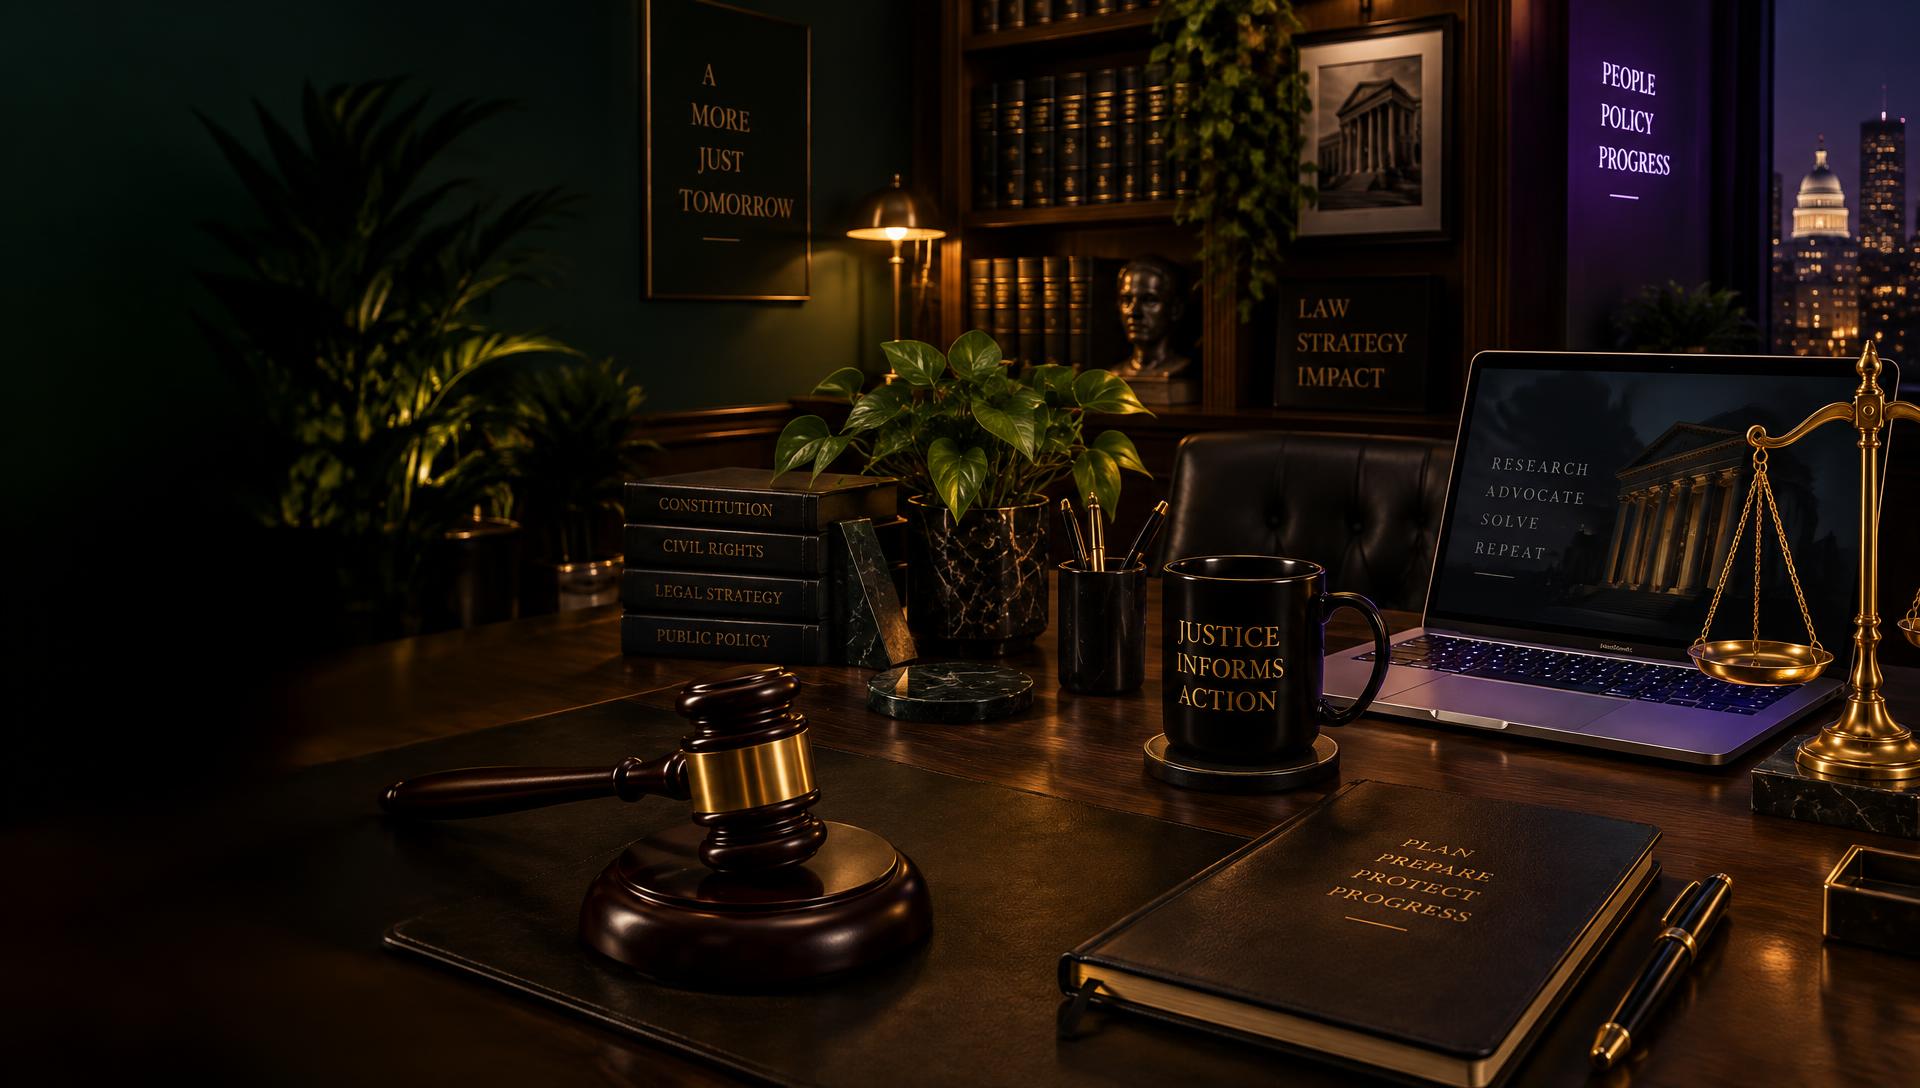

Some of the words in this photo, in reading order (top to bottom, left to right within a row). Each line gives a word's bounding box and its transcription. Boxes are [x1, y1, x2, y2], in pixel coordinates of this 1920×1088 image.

[702, 63, 717, 87] A
[1602, 61, 1656, 96] PEOPLE
[690, 102, 751, 133] MORE
[1601, 103, 1654, 135] POLICY
[697, 146, 744, 174] JUST
[1598, 145, 1671, 176] PROGRESS
[678, 187, 796, 218] TOMORROW
[1297, 298, 1350, 319] LAW
[1296, 332, 1409, 353] STRATEGY
[1297, 366, 1385, 389] IMPACT
[1491, 456, 1589, 476] RESEARCH
[658, 496, 773, 518] CONSTITUTION
[1485, 485, 1585, 505] ADVOCATE
[1480, 512, 1539, 530] SOLVE
[662, 538, 704, 555] CIVIL
[708, 542, 764, 559] RIGHTS
[1474, 541, 1546, 560] REPEAT
[655, 583, 702, 600] LEGAL
[705, 586, 783, 605] STRATEGY
[656, 628, 711, 645] PUBLIC
[716, 632, 771, 649] POLICY
[1177, 619, 1280, 648] JUSTICE
[1176, 651, 1284, 680] INFORMS
[1177, 684, 1278, 712] ACTION
[1400, 838, 1476, 859] PLAN
[1375, 853, 1495, 883] PREPARE
[1351, 868, 1482, 902] PROTECT
[1326, 885, 1473, 923] PROGRESS
